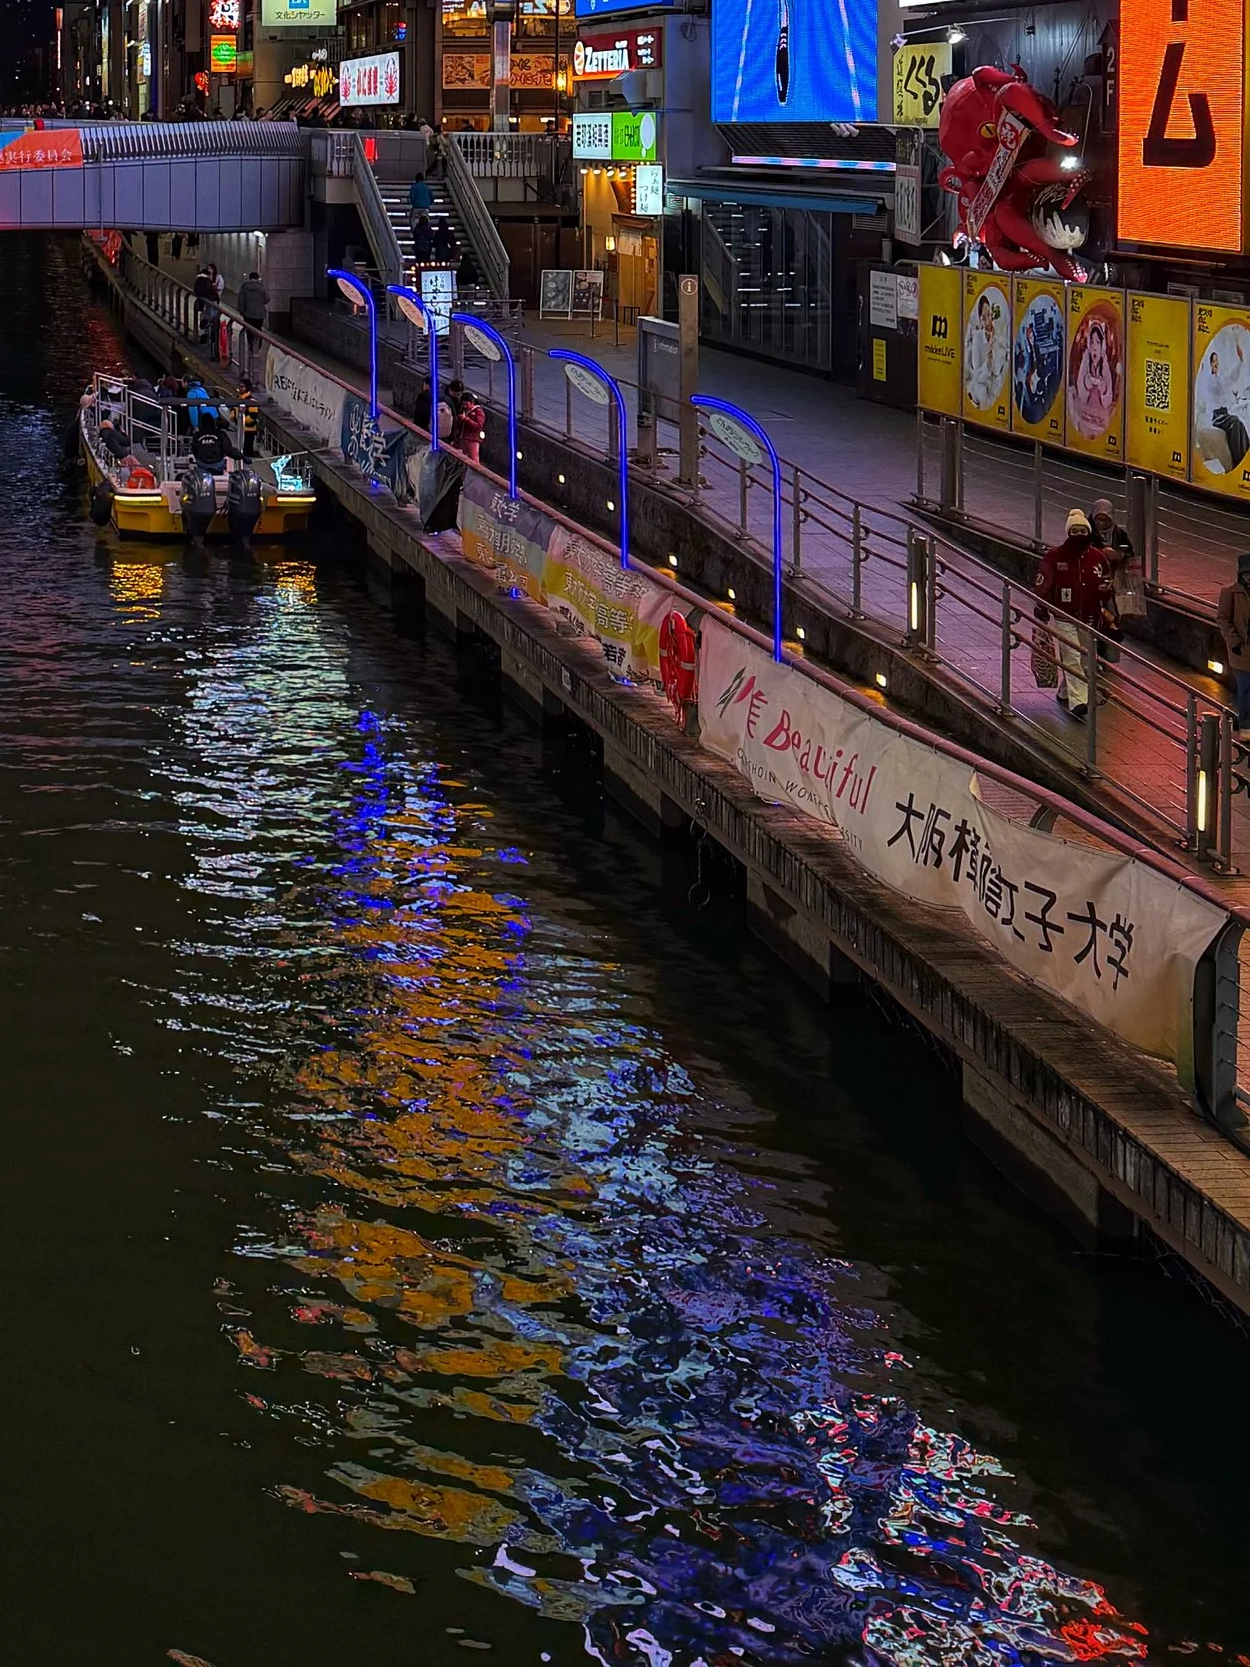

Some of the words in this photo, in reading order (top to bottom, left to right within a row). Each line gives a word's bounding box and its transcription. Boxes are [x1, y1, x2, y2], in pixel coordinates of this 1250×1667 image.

[275, 10, 326, 20] 文化シャッター
[585, 45, 629, 72] ZETTERIA
[1105, 49, 1116, 107] 2F
